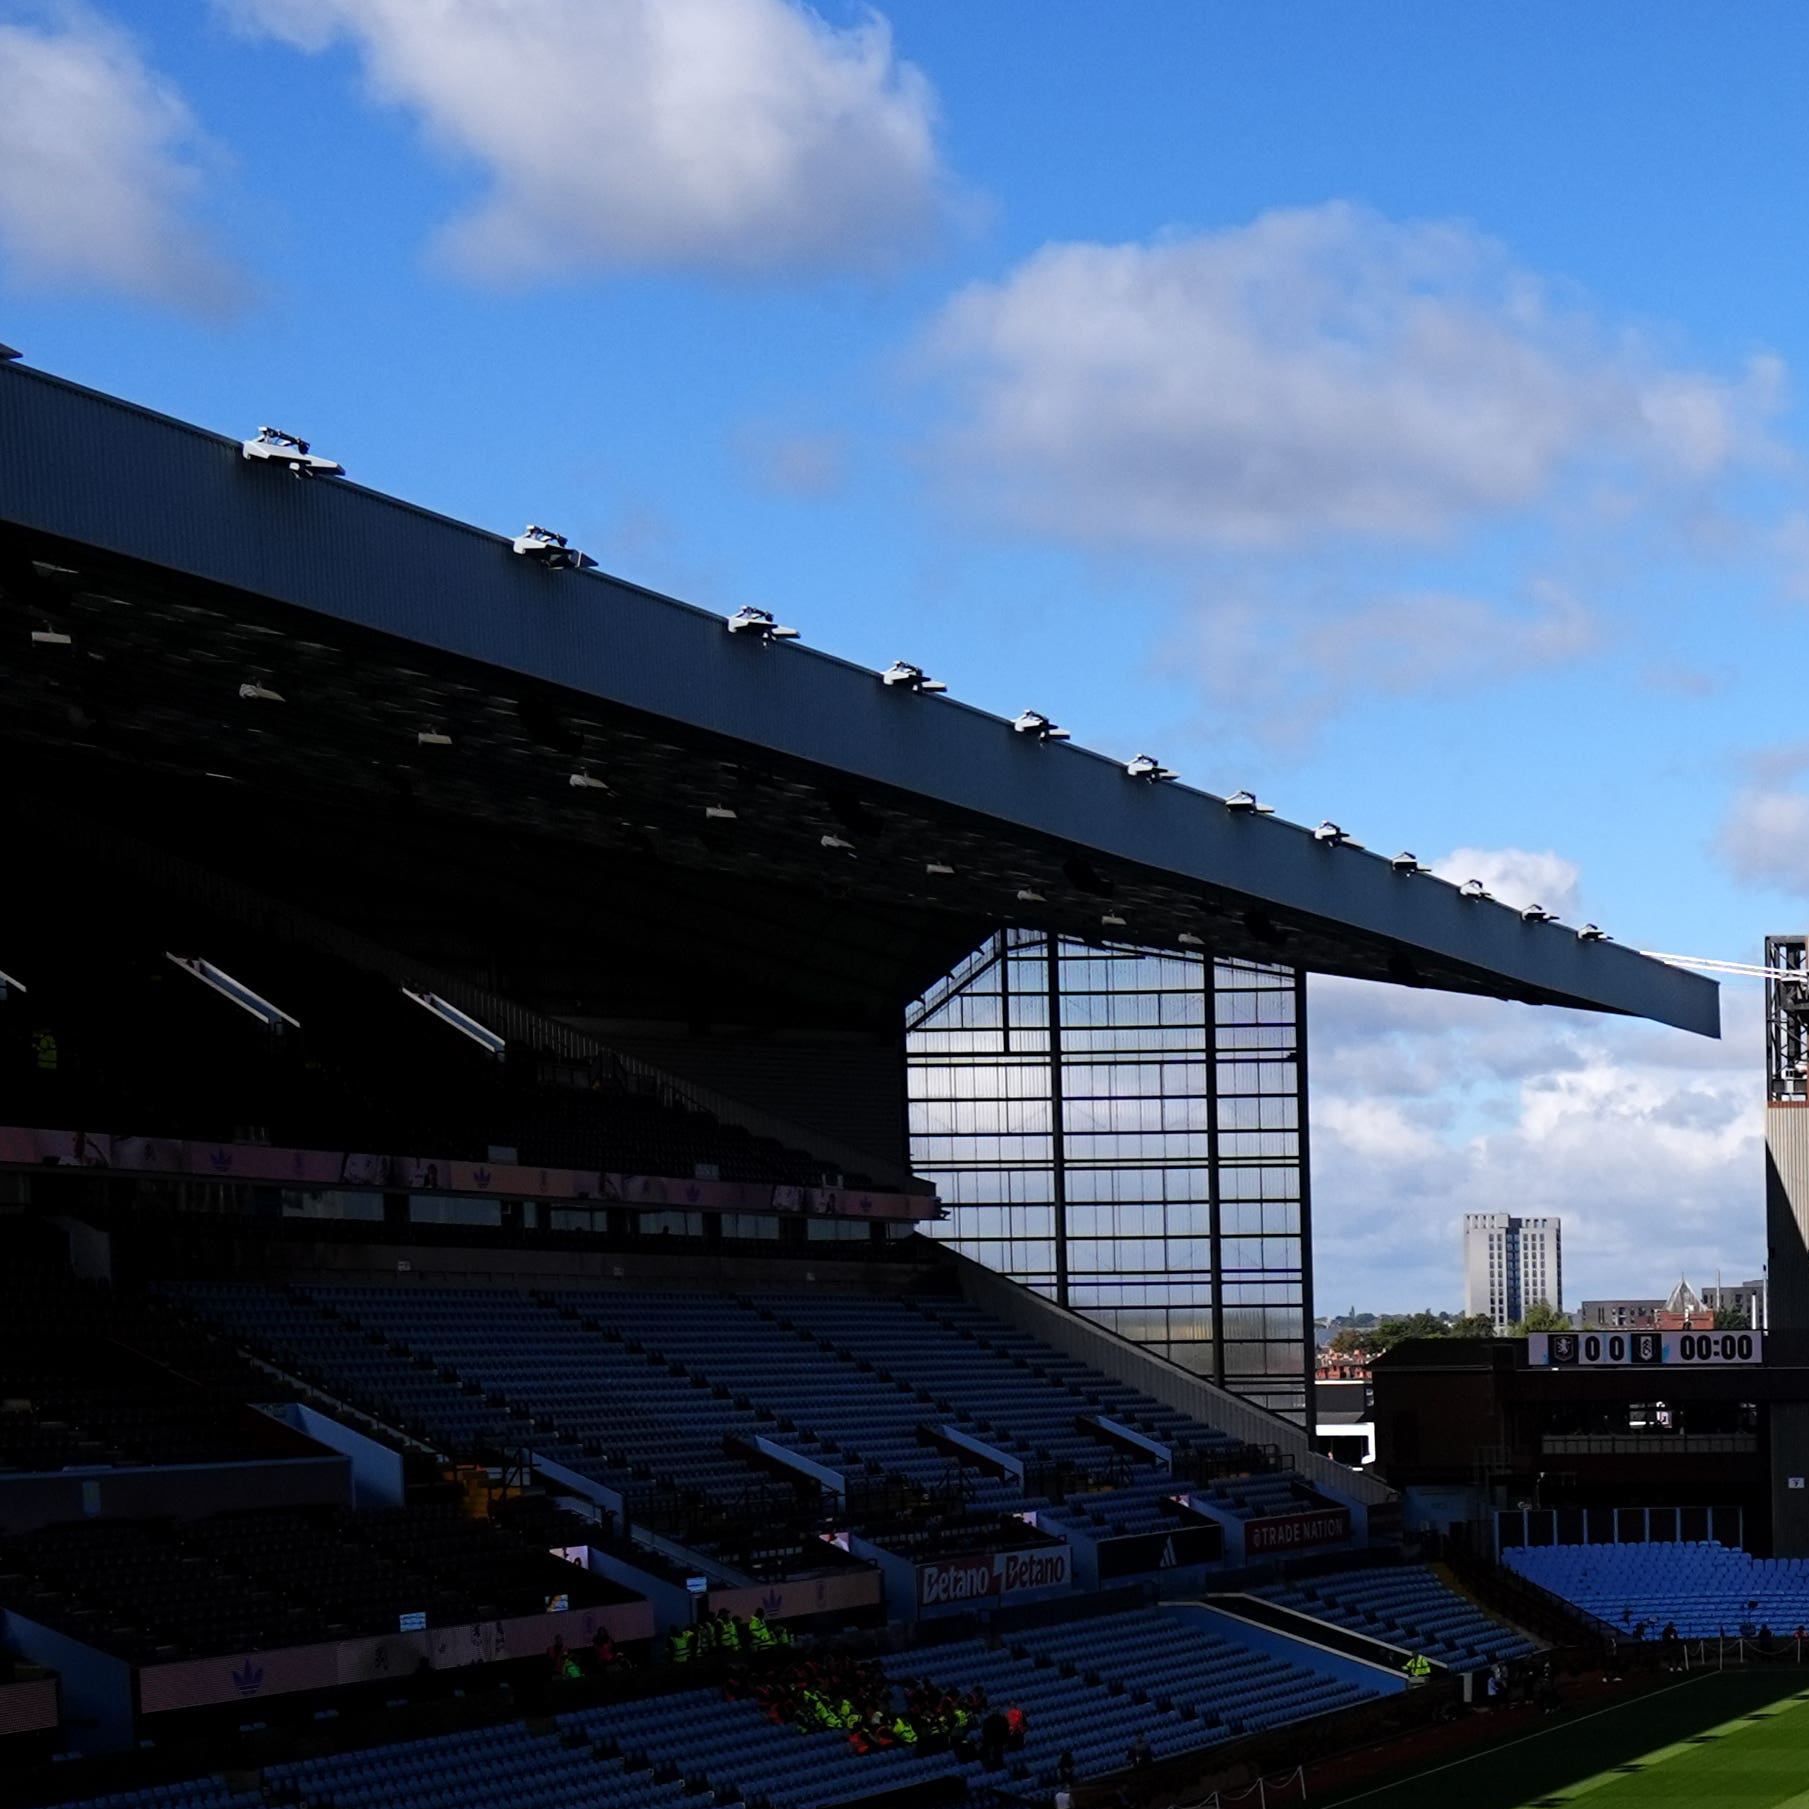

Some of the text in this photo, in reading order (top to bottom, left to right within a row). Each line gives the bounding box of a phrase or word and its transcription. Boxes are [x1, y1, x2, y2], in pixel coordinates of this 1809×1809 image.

[1585, 1335, 1752, 1361] 0 0 00:00
[1262, 1518, 1343, 1545] TRADE NATION
[922, 1555, 1064, 1605] Betano Betano
